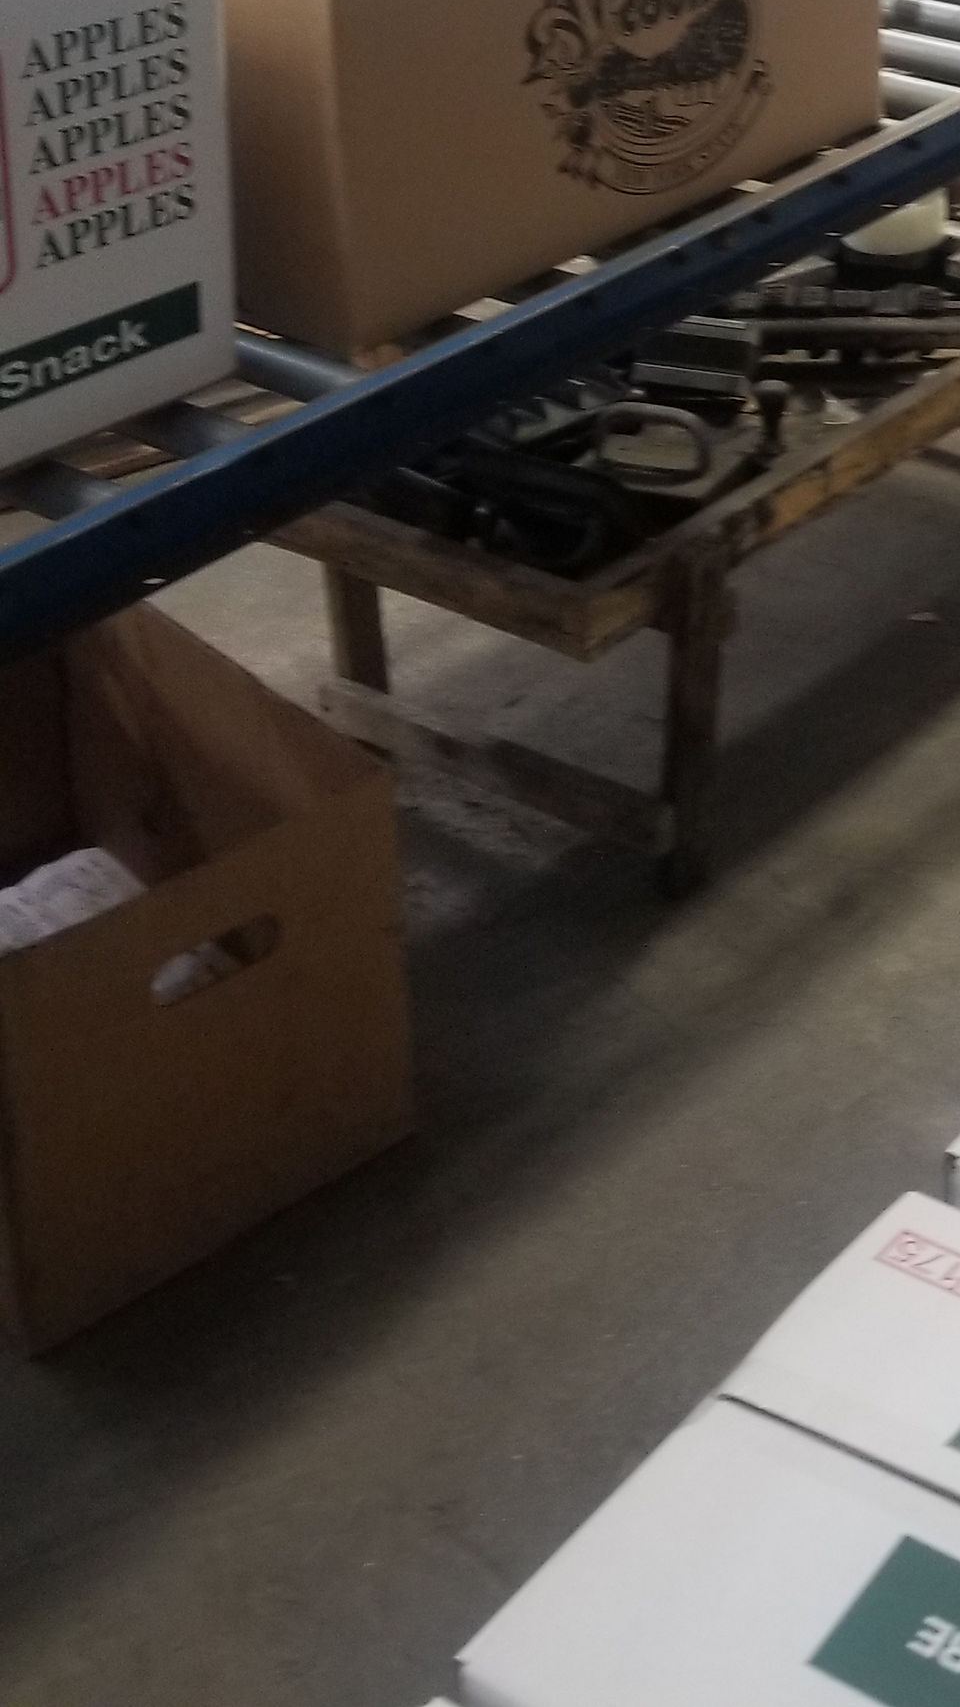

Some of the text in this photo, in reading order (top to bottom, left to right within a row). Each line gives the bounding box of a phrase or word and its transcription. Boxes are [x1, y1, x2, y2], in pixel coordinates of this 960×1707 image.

[21, 1, 187, 80] APPLES
[25, 47, 191, 127] APPLES
[29, 93, 193, 174] APPLES
[32, 139, 195, 224] APPLES
[35, 182, 196, 270] APPLES
[0, 320, 149, 399] Snack
